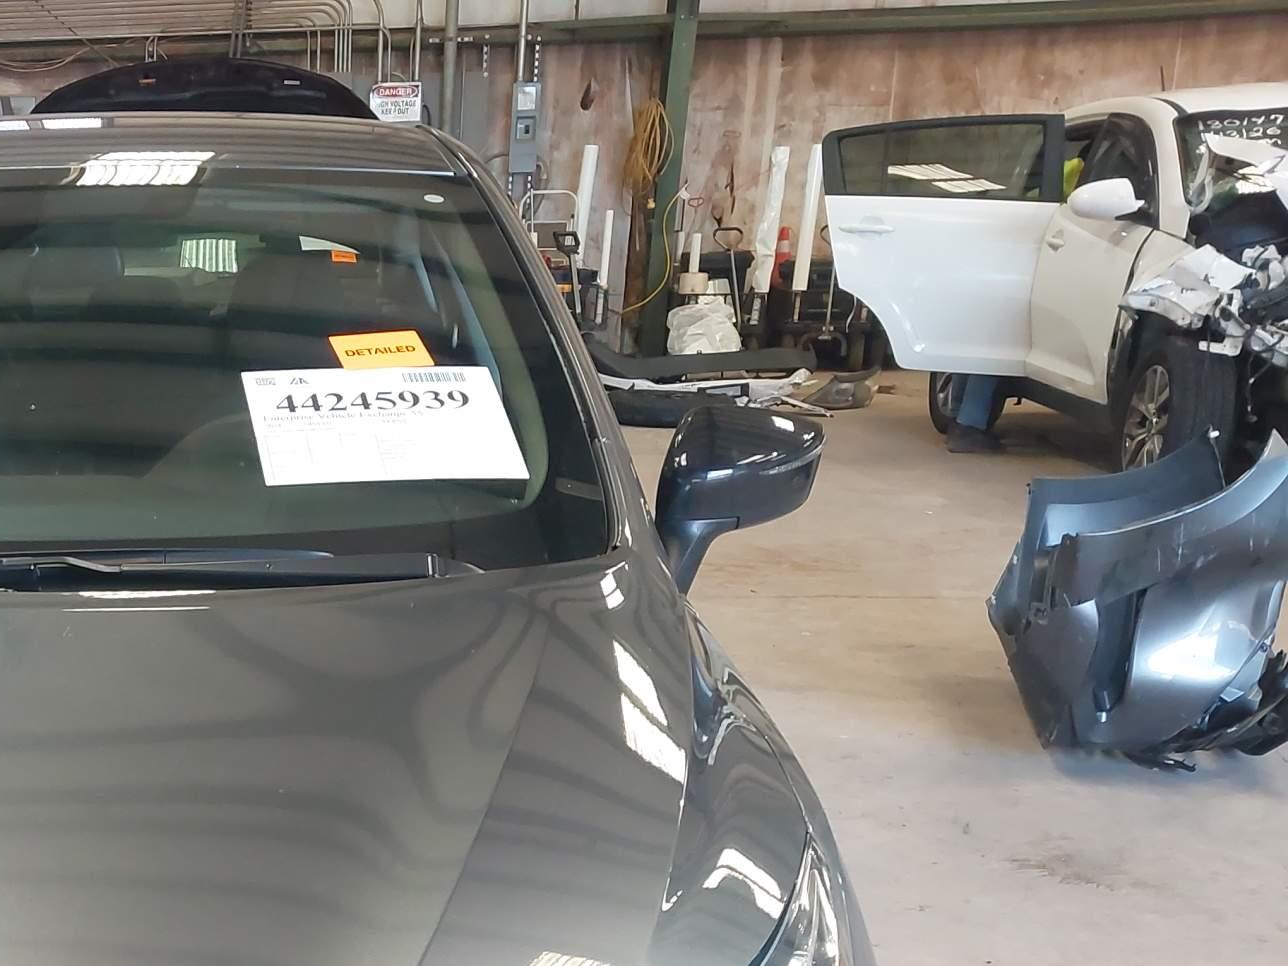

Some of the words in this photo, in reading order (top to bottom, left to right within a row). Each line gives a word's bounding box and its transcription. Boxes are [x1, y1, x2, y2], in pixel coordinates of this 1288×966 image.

[379, 87, 413, 96] DANGER
[390, 99, 417, 108] VOLTAGE
[397, 107, 409, 115] OUT
[344, 345, 417, 357] DETAILED
[275, 389, 470, 413] 44245939
